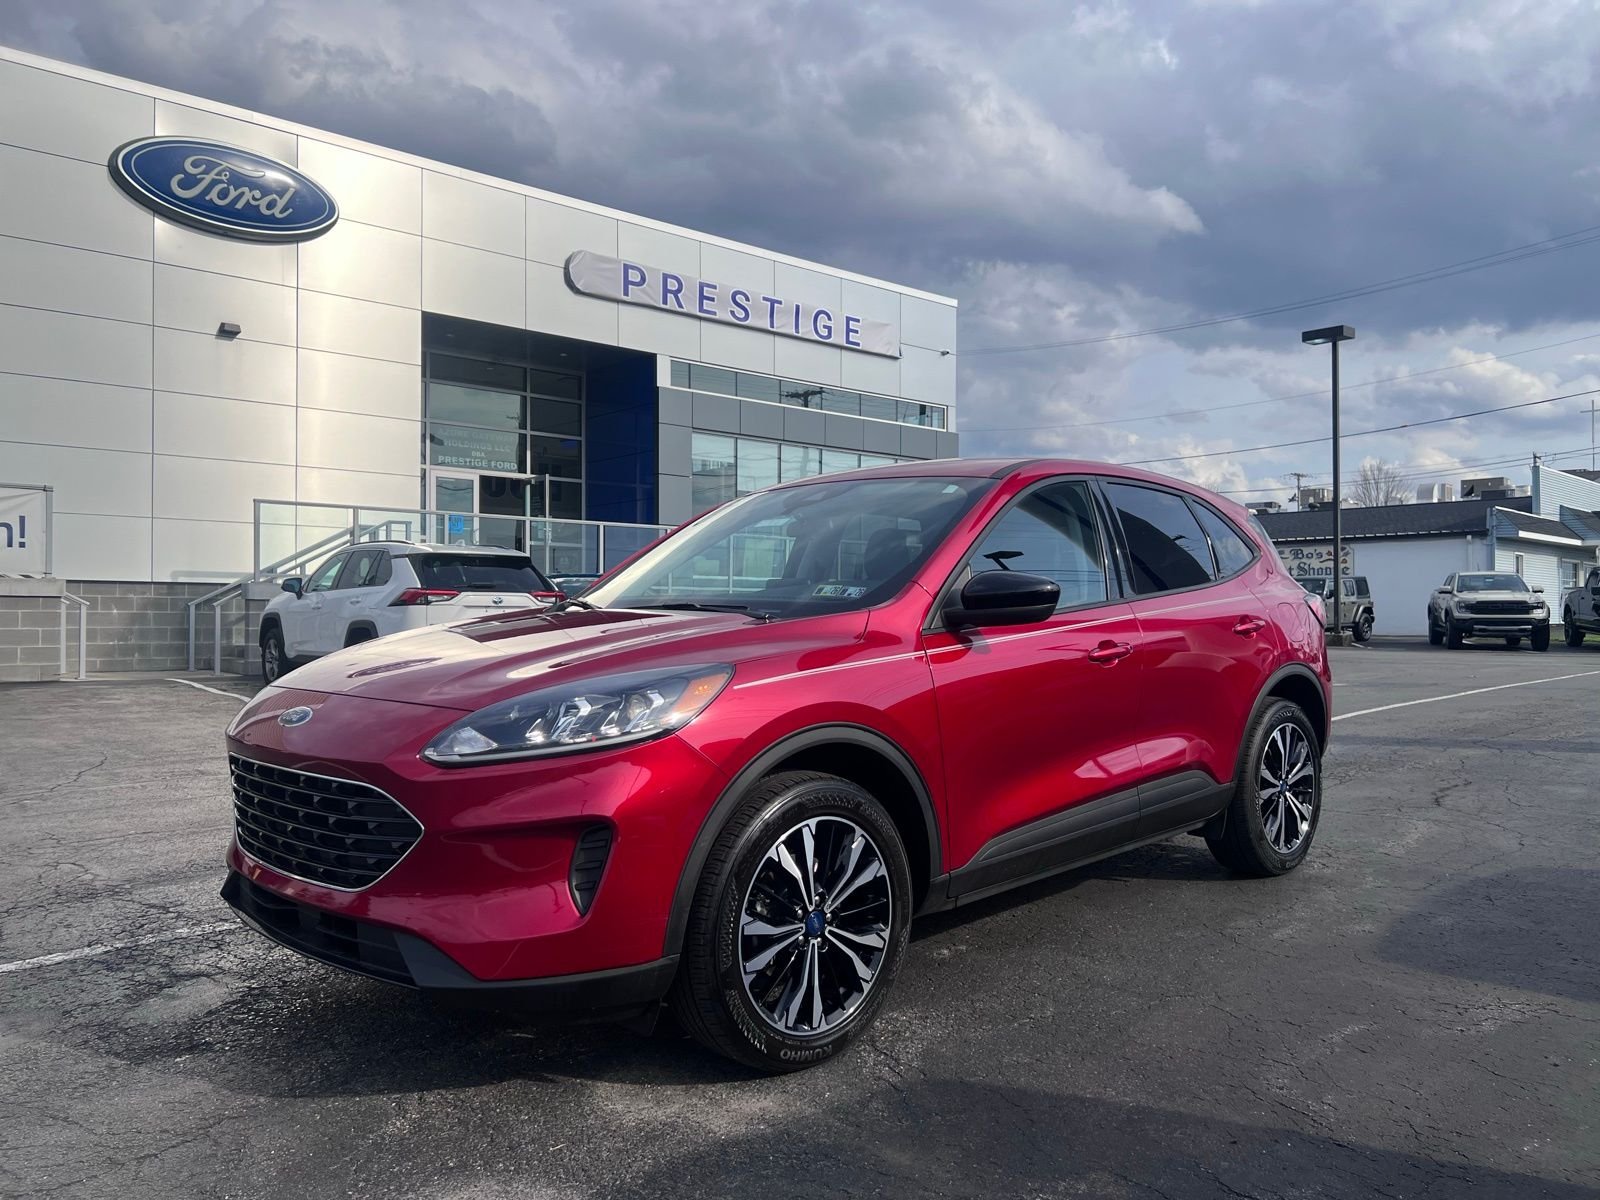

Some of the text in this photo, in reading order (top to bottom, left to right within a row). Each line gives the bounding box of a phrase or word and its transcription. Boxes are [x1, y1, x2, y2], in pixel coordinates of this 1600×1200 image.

[170, 155, 295, 219] Ford
[621, 262, 862, 348] PRESTIGE
[438, 456, 517, 471] PRESTIGE FORD
[1290, 548, 1323, 561] Bo's
[1296, 561, 1350, 577] Shope
[780, 1045, 833, 1061] KUMHO
